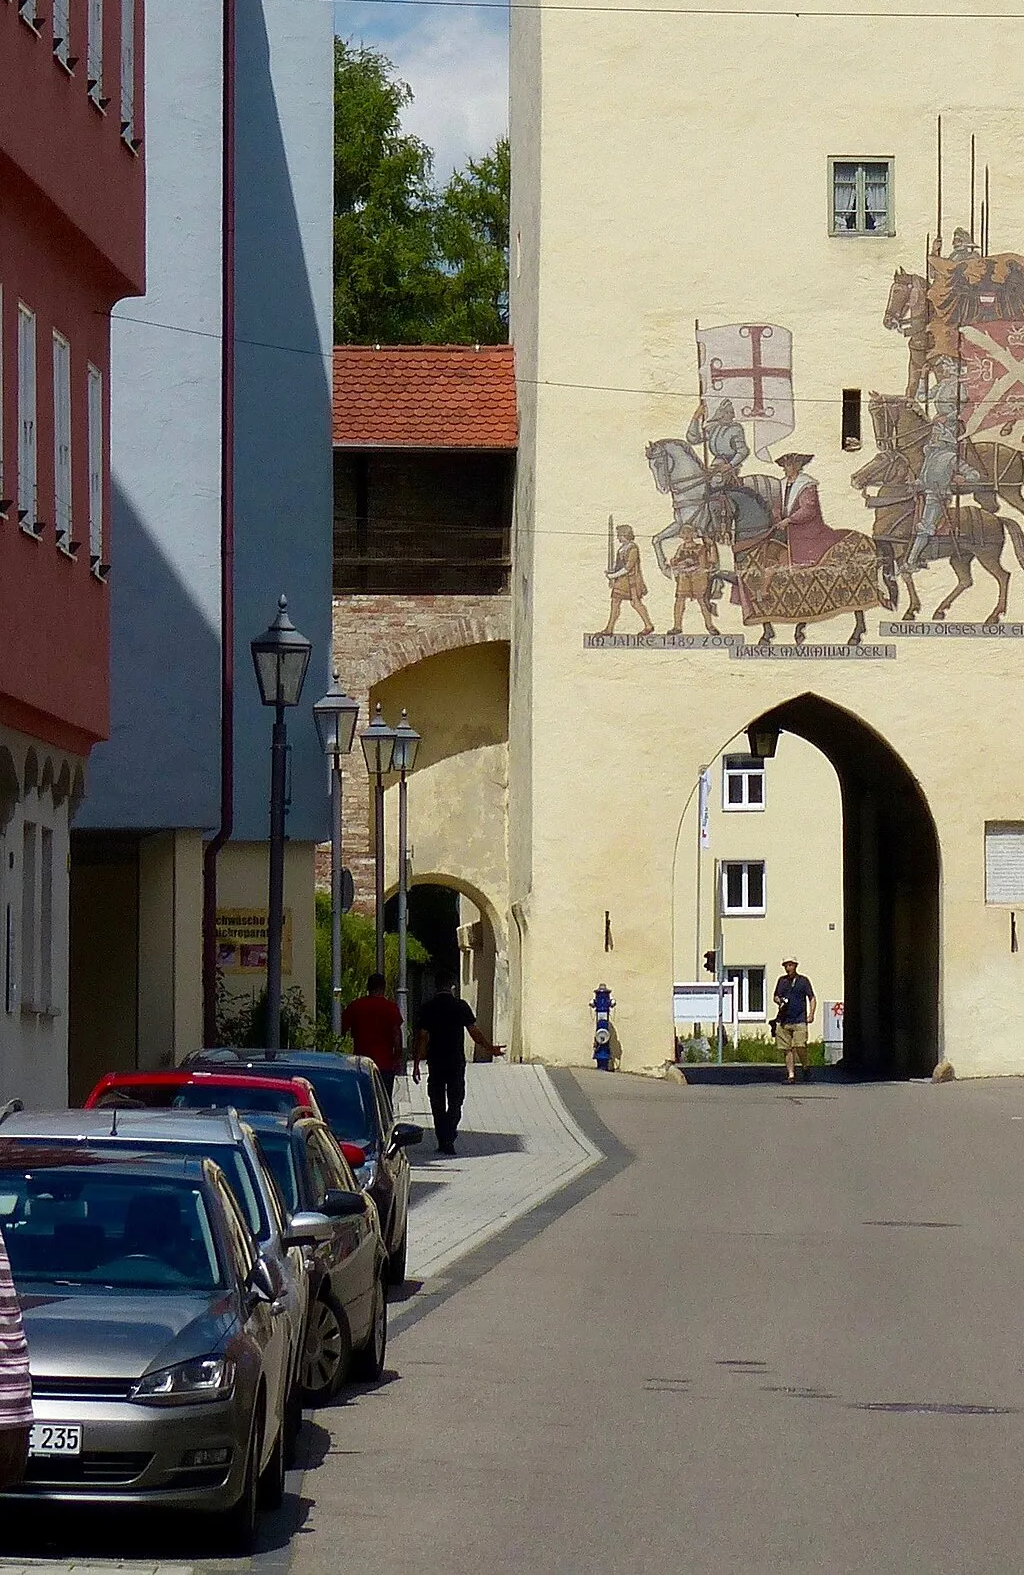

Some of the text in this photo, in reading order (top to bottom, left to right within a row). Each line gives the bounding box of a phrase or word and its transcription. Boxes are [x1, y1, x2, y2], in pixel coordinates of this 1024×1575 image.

[934, 623, 976, 635] DIESES
[701, 636, 736, 647] ZOG
[735, 645, 777, 657] KAISER
[41, 1427, 79, 1450] 235
